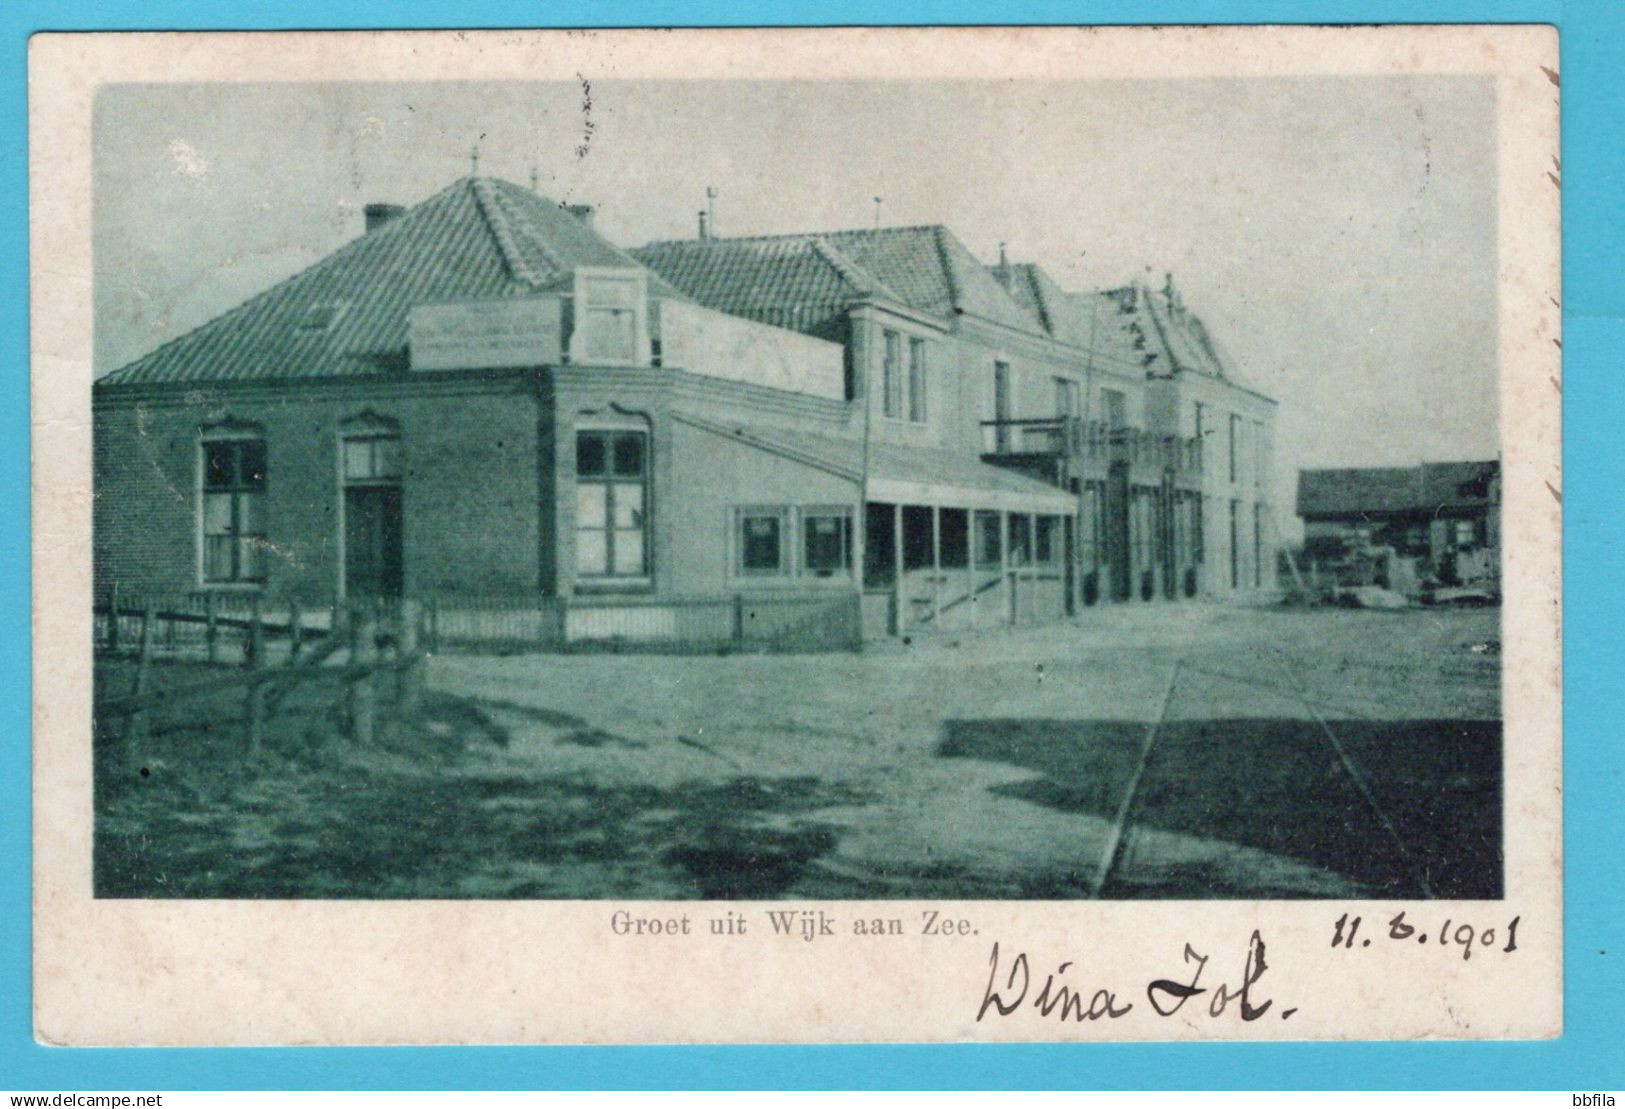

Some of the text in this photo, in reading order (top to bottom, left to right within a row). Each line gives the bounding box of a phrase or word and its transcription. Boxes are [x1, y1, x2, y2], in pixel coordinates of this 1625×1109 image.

[610, 910, 980, 943] Groet uit Wijk aan Zee.
